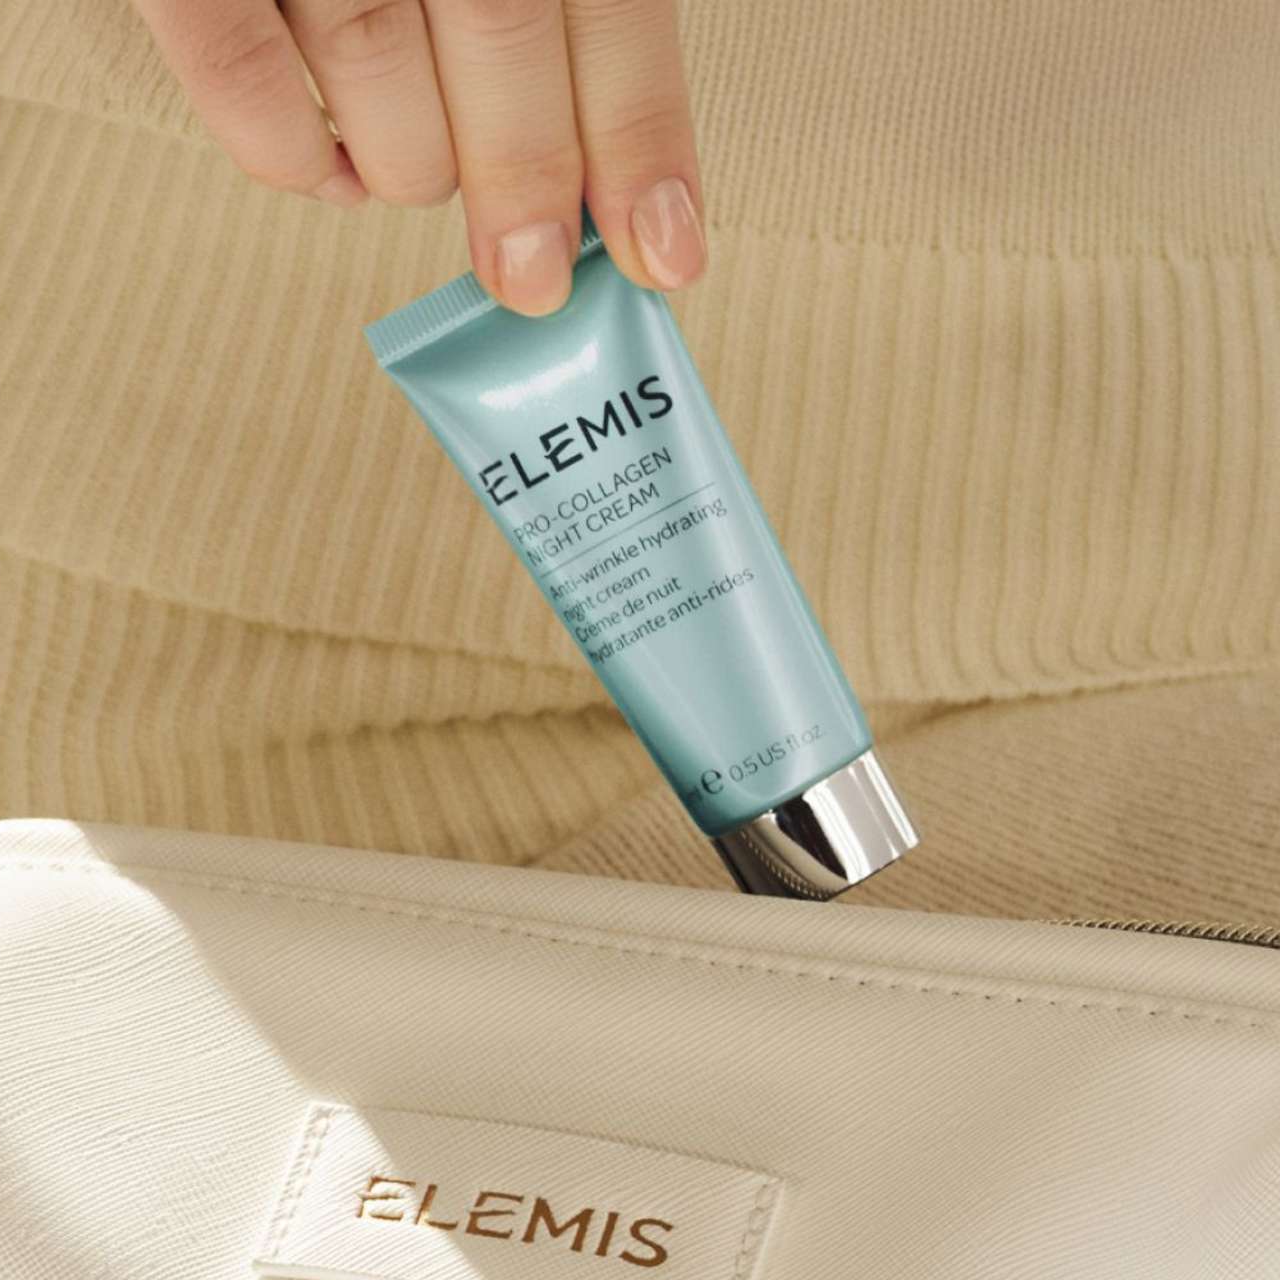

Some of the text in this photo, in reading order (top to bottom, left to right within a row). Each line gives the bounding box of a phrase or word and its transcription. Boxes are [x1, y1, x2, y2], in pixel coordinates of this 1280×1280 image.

[479, 375, 673, 506] ELEMIS
[514, 446, 673, 544] PRO-COLLAGEN
[526, 482, 660, 568] NIGHT CREAM
[549, 497, 728, 601] Anti-wrinkle hydrating
[596, 566, 652, 605] cream
[622, 596, 647, 619] de
[646, 575, 682, 603] nuit
[668, 566, 754, 622] anti-rides
[757, 742, 786, 767] US
[355, 1174, 675, 1269] ELEMIS
